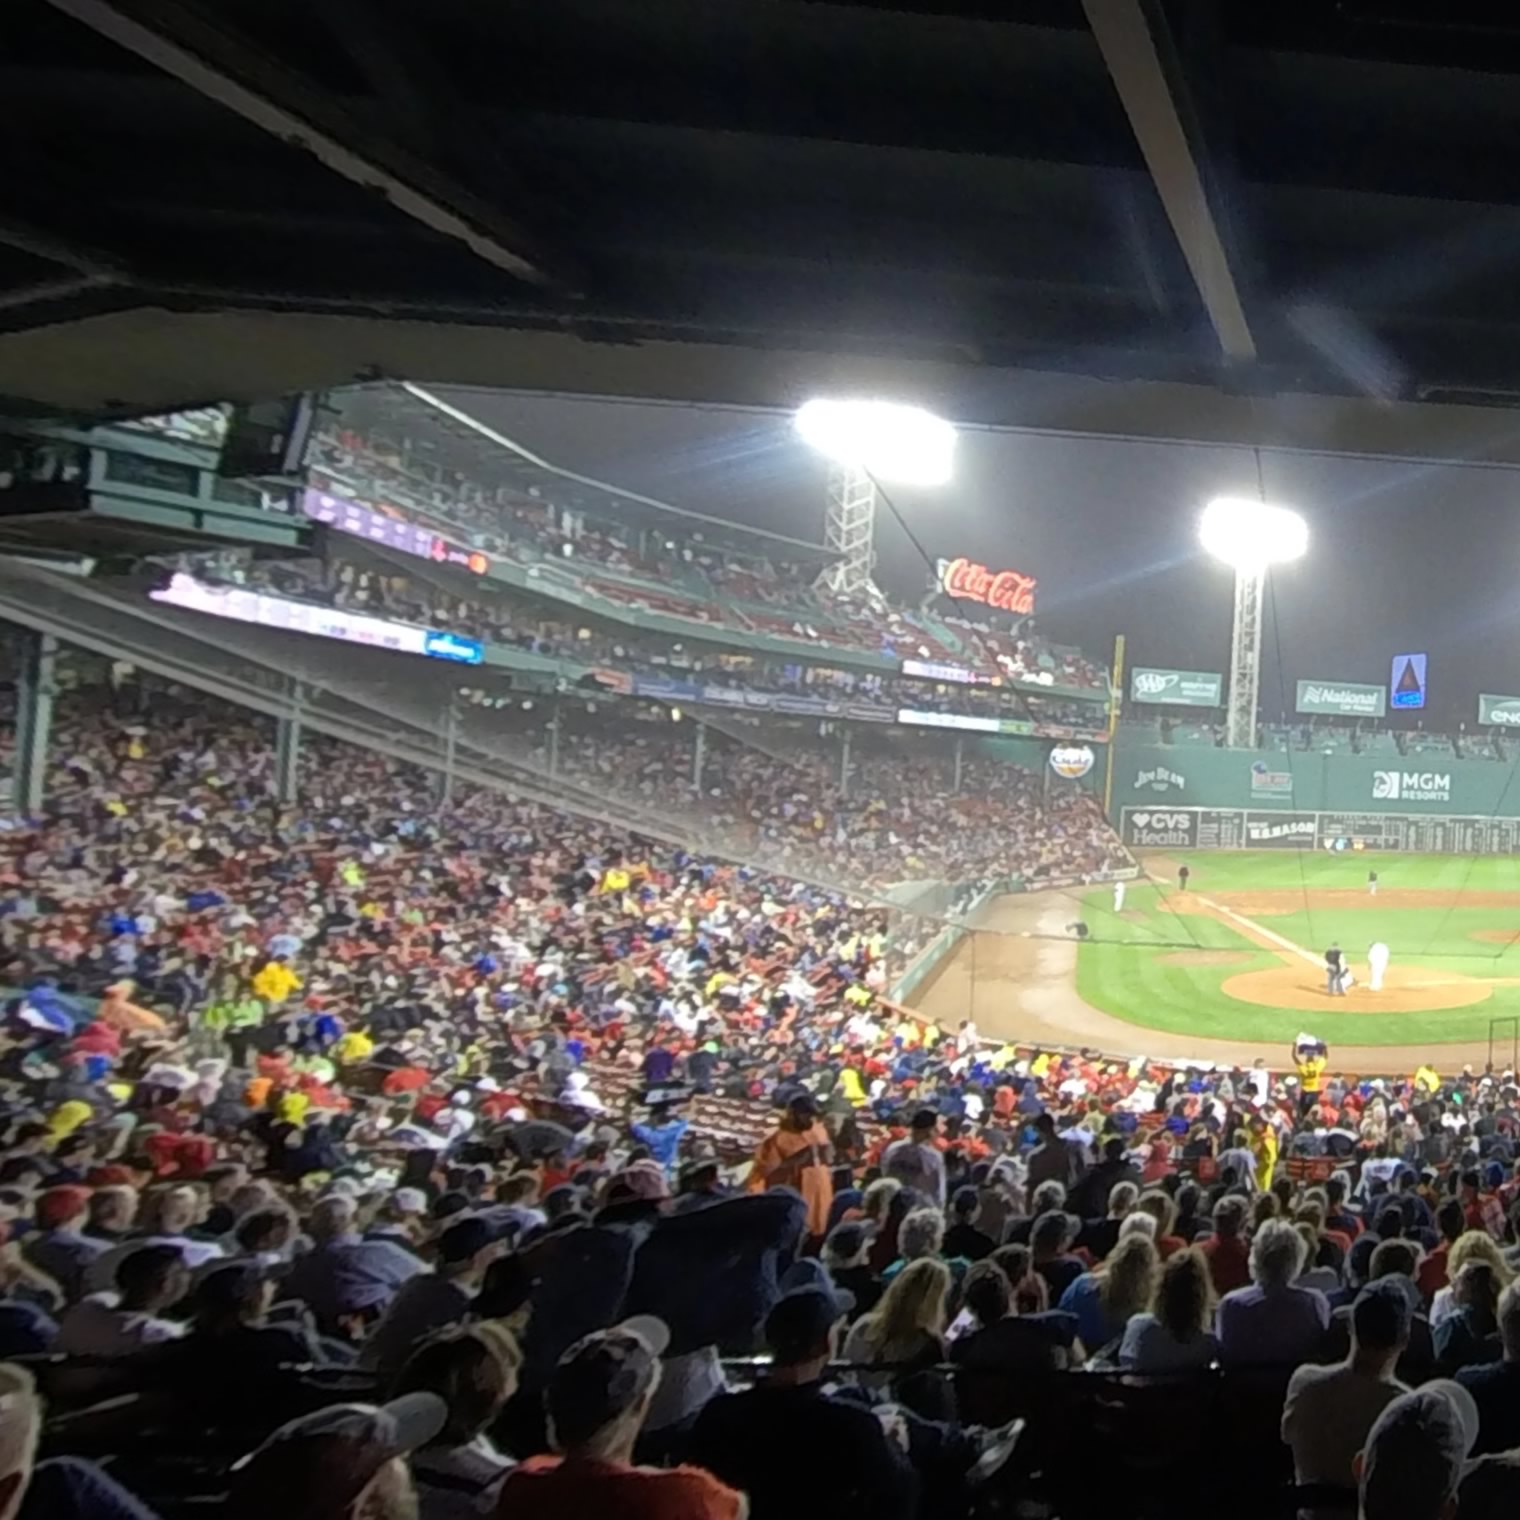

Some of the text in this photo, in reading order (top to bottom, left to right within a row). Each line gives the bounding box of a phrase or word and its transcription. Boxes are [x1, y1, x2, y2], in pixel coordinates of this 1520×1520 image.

[1321, 690, 1378, 705] National
[1401, 772, 1450, 791] MGM
[1401, 790, 1450, 801] RESORTS
[1151, 812, 1191, 830] CVS
[1132, 828, 1190, 846] Health
